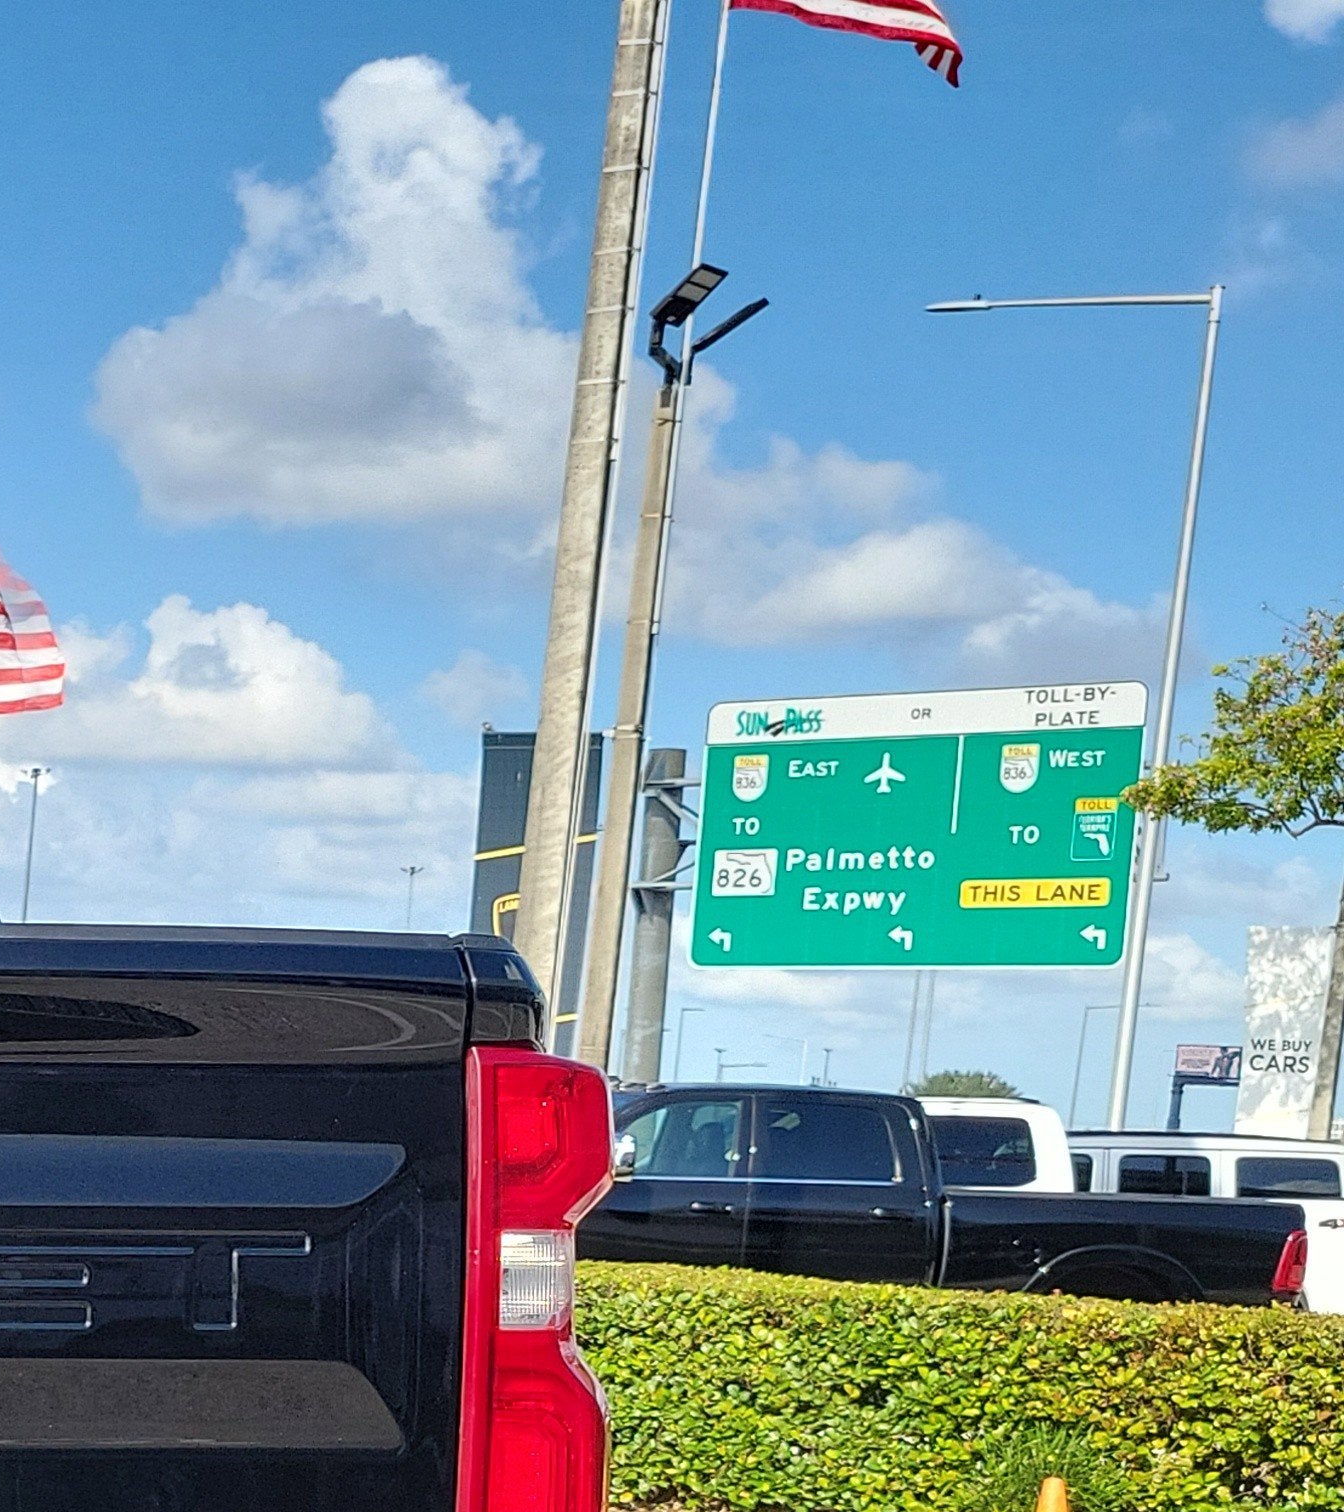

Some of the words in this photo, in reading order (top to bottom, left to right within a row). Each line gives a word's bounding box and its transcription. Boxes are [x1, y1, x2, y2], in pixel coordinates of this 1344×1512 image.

[1025, 686, 1117, 704] TOLL-BY-
[911, 708, 932, 720] OR
[1034, 711, 1100, 727] PLATE
[1049, 749, 1106, 768] WEST
[788, 760, 839, 778] EAST
[1004, 767, 1027, 780] 836
[735, 776, 757, 789] 836
[1081, 800, 1112, 810] TOLL
[732, 817, 760, 836] TO
[1009, 825, 1040, 844] TO
[785, 845, 936, 872] Palmetto
[717, 868, 762, 888] 826
[802, 887, 907, 916] Expwy
[970, 885, 1021, 902] THIS
[1036, 884, 1101, 901] LANE
[1251, 1039, 1276, 1051] WE
[1282, 1040, 1312, 1052] BUY
[1249, 1055, 1310, 1073] CARS
